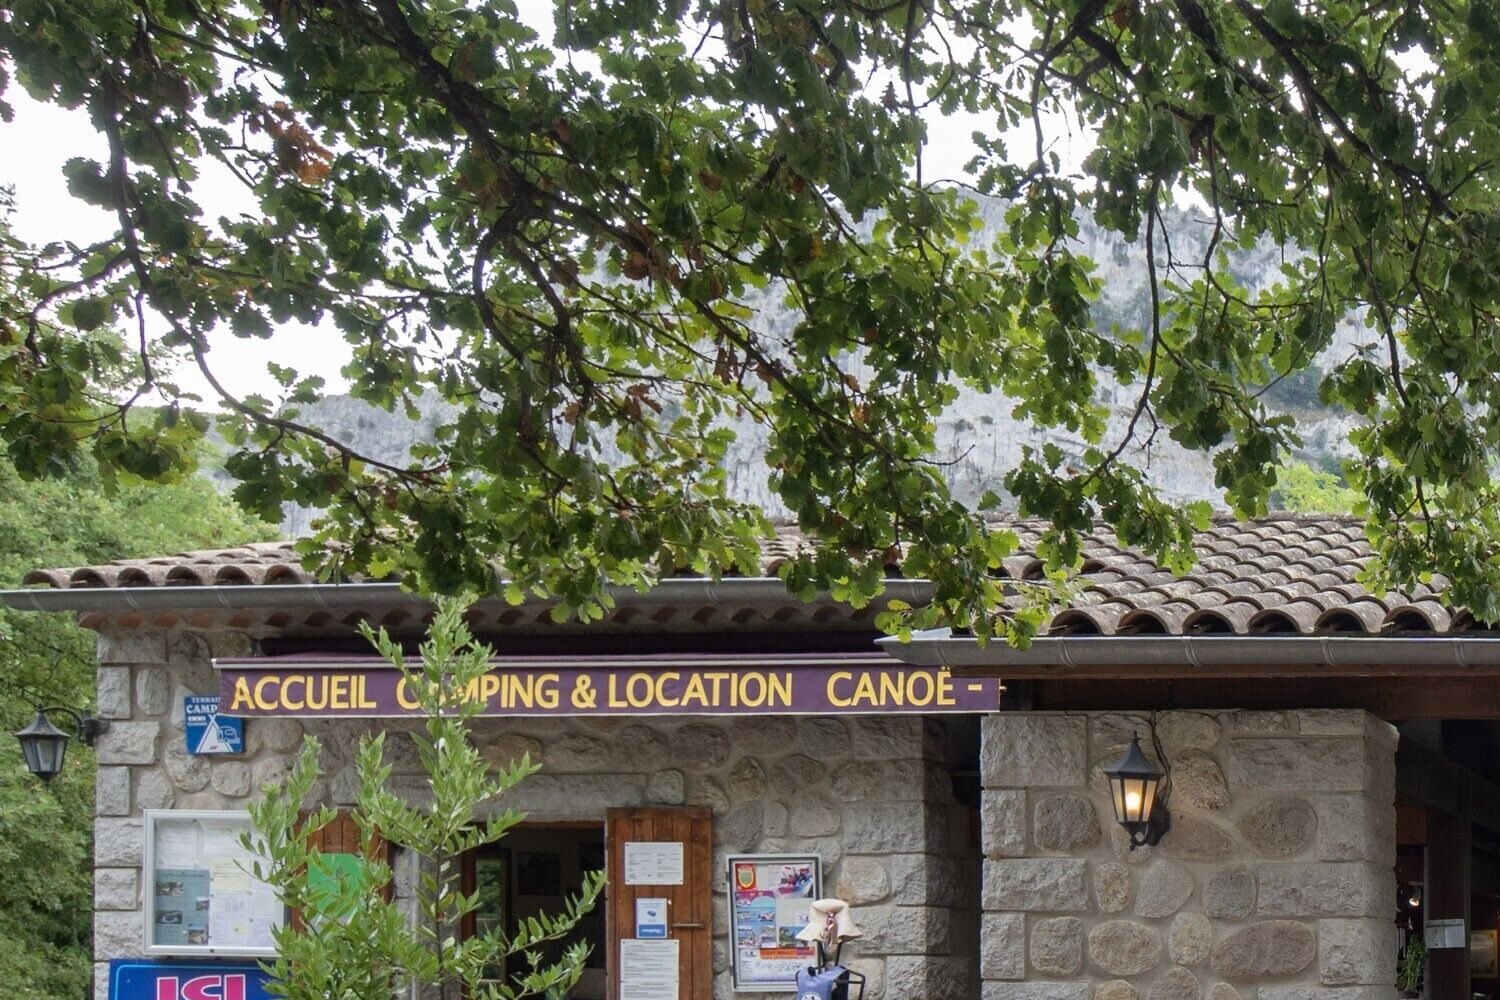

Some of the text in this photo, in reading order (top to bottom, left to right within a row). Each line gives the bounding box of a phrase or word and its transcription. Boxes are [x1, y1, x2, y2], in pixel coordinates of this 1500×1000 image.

[230, 675, 377, 710] ACCUEIL
[571, 674, 597, 709] &
[608, 672, 793, 708] LOCATION
[186, 704, 218, 713] CAMP
